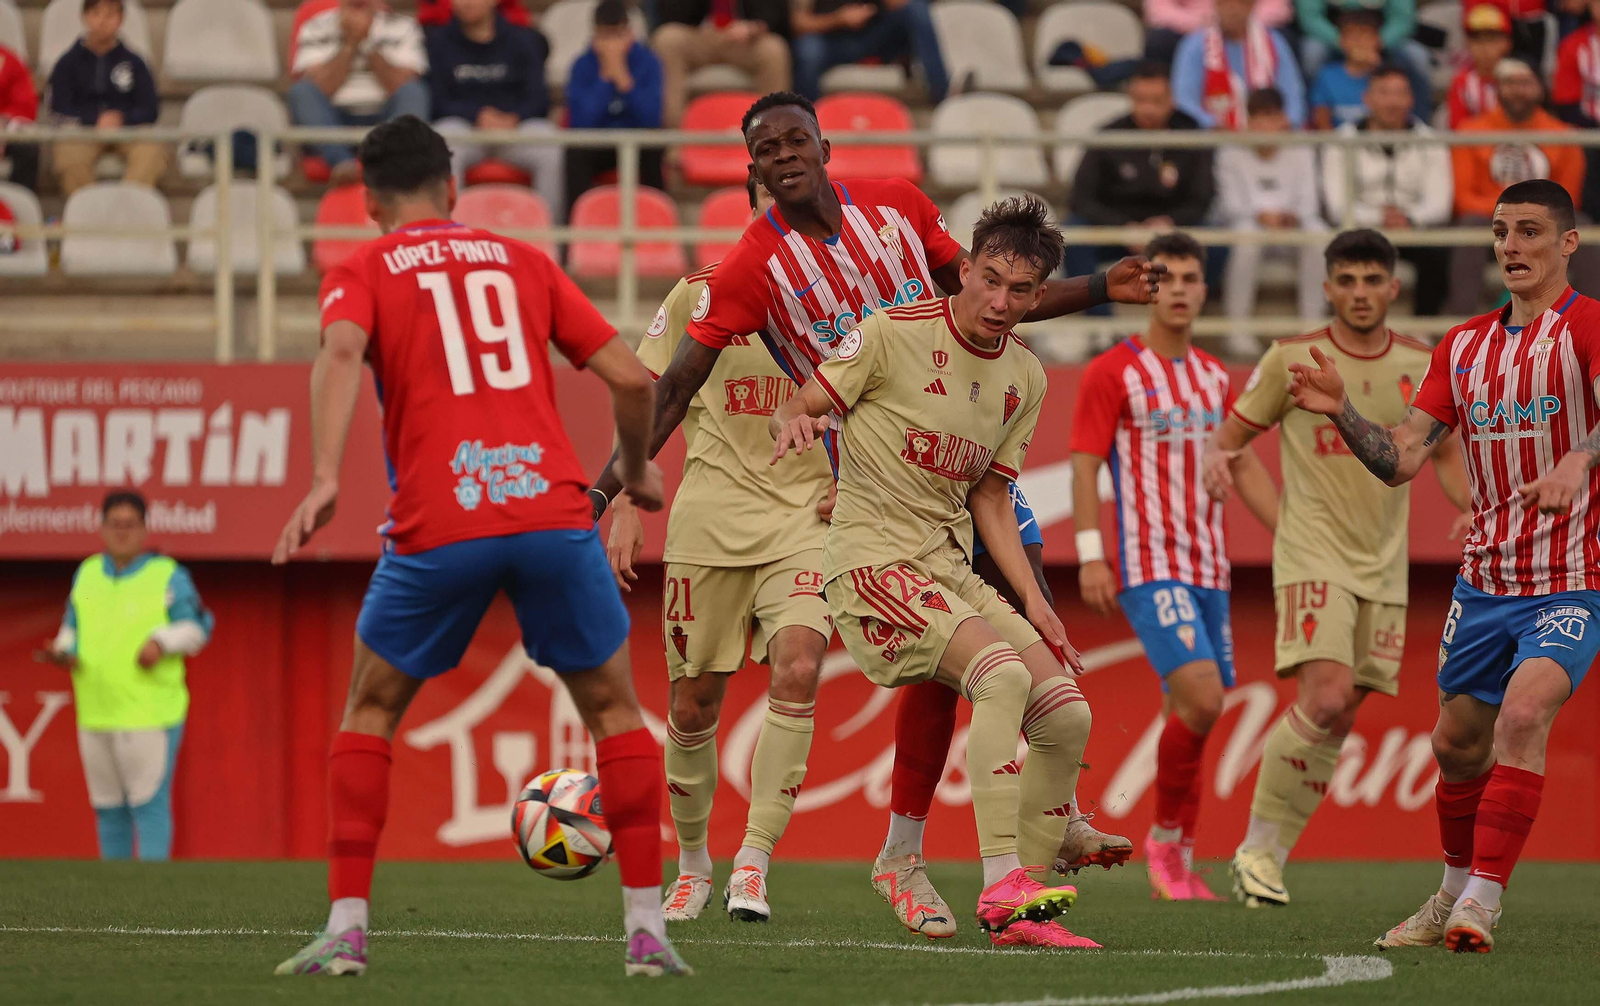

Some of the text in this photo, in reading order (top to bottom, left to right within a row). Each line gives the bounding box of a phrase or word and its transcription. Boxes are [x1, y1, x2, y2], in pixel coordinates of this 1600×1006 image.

[381, 238, 511, 275] LÓPEZ-PINTO
[416, 269, 532, 396] 19
[1150, 404, 1225, 431] SCAM
[1464, 394, 1561, 427] CAMP
[666, 577, 695, 621] 21
[881, 630, 907, 663] DFM
[0, 690, 72, 803] Y
